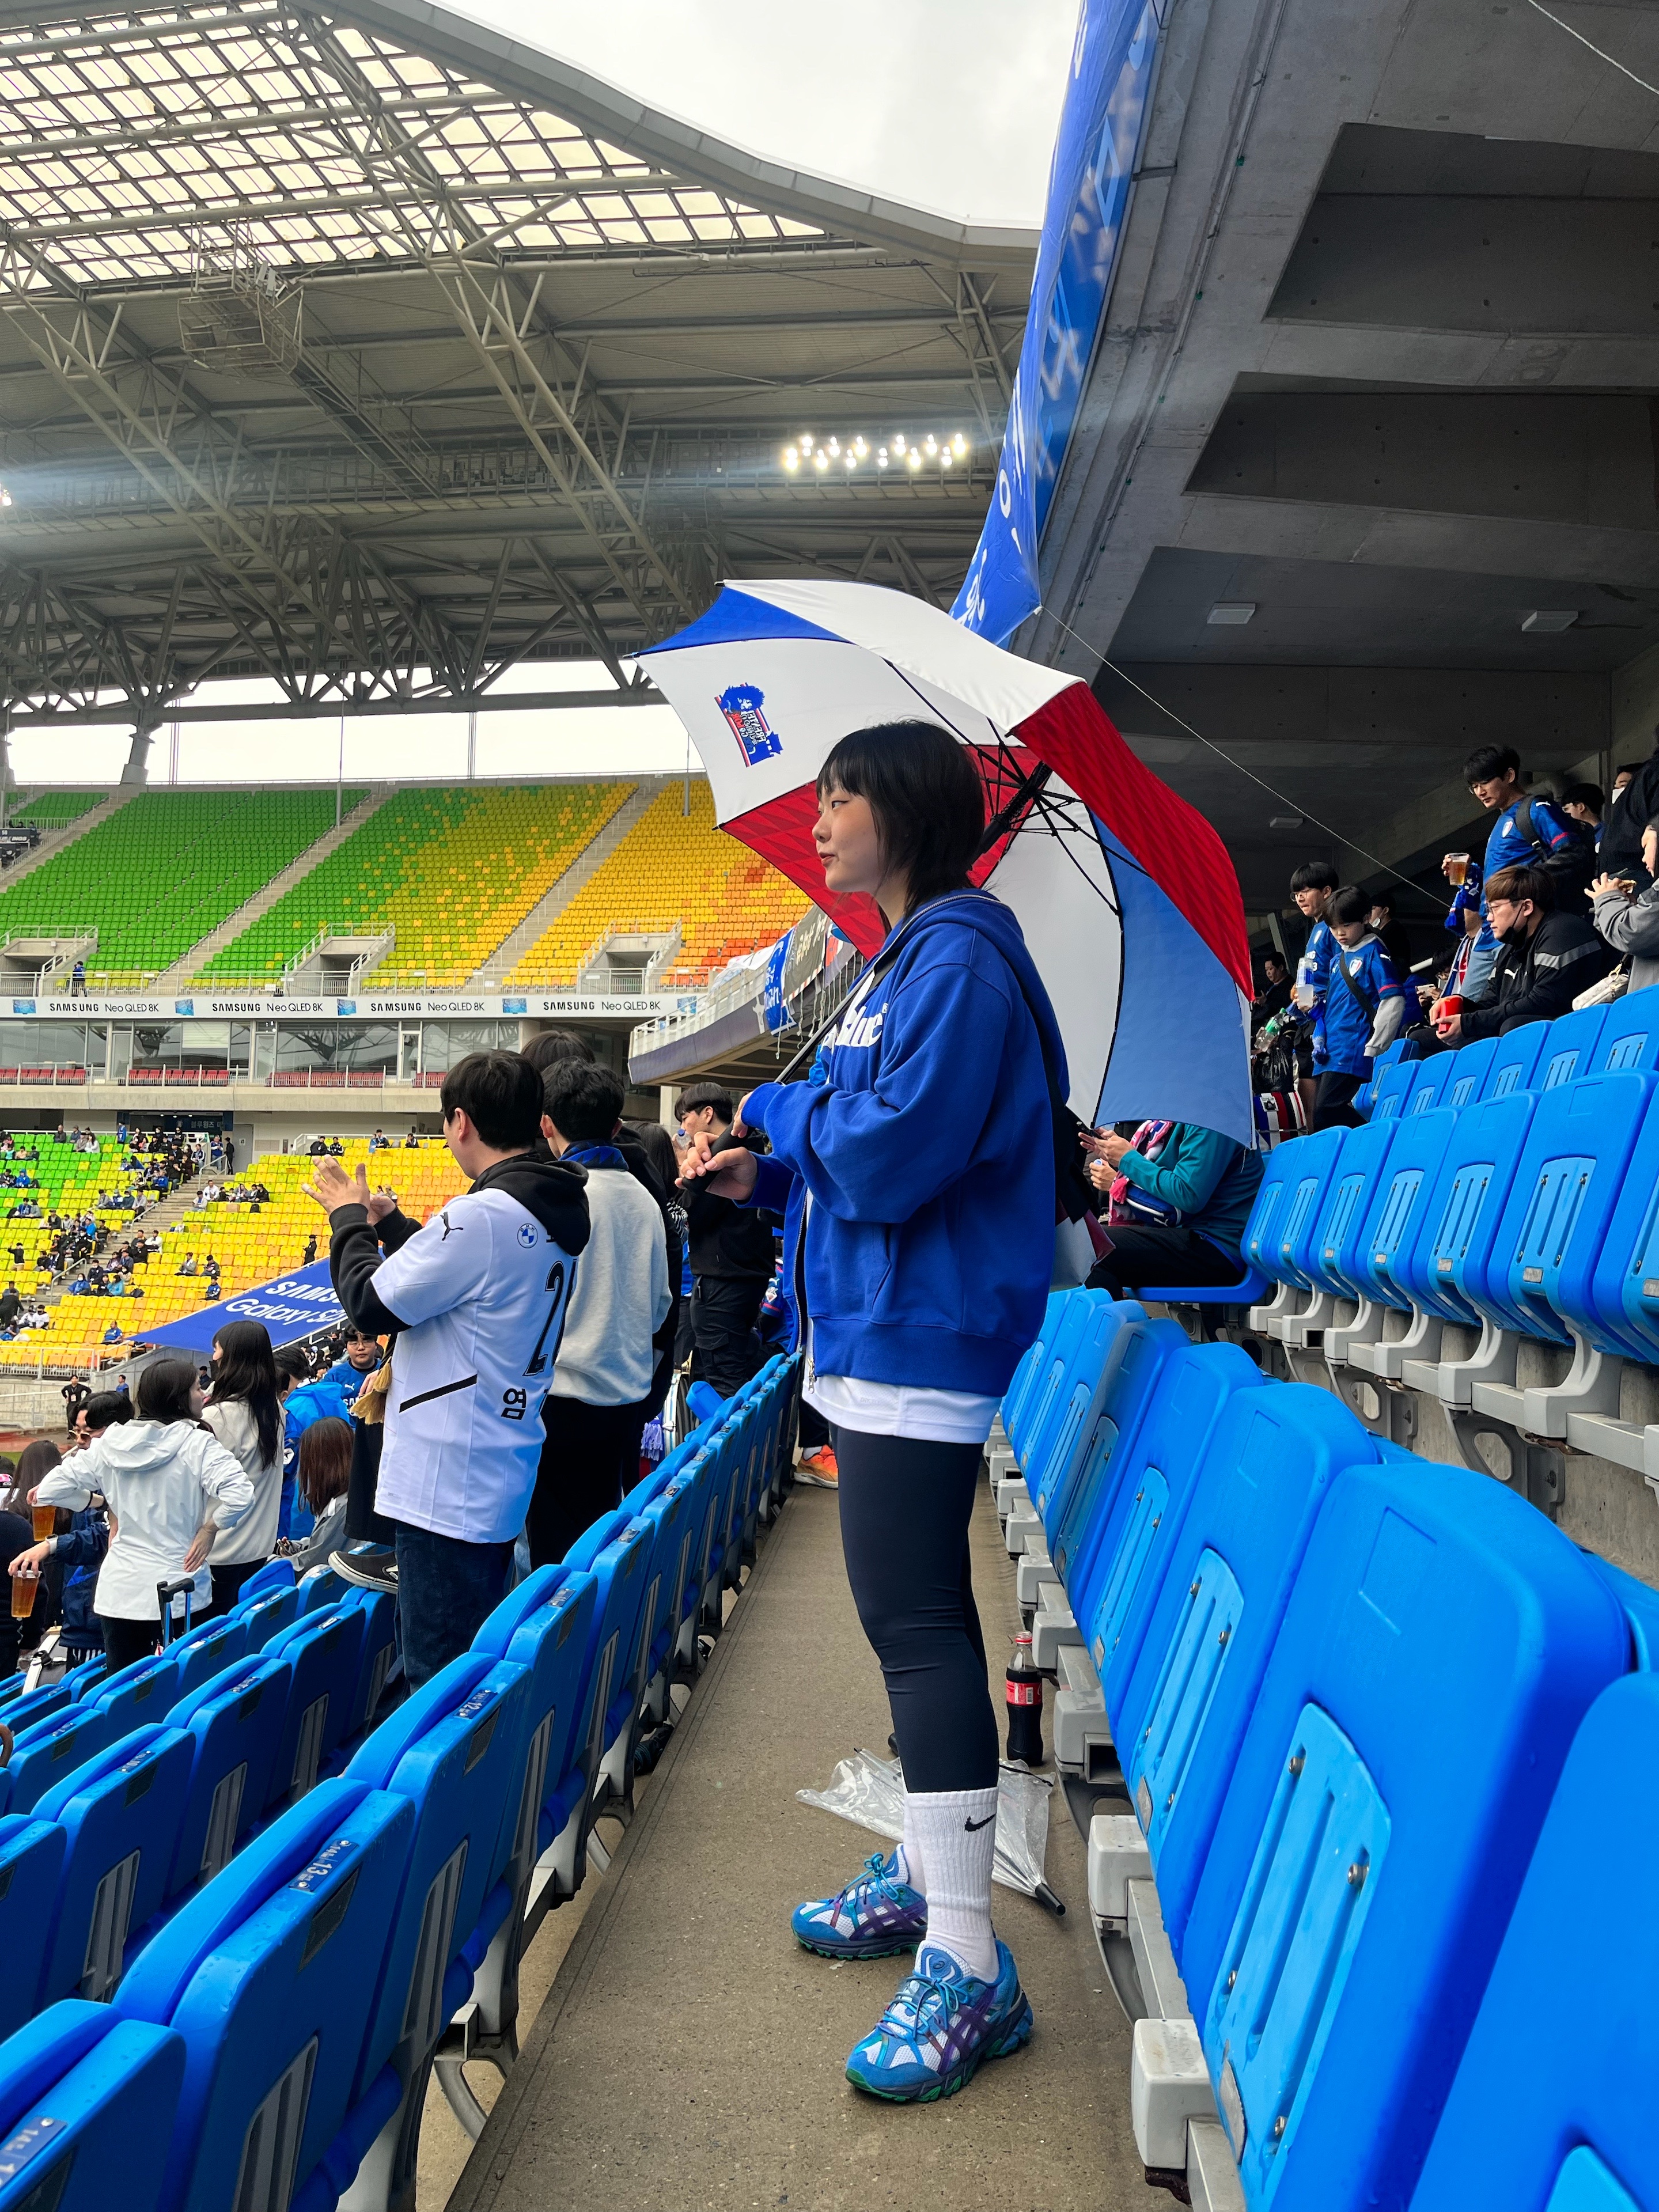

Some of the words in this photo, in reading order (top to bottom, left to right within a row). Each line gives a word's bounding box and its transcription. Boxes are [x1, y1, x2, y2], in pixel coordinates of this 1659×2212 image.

[50, 1003, 99, 1012] SAMSUNG
[105, 1003, 124, 1012] Neo
[124, 1003, 147, 1012] QLED
[149, 1003, 159, 1012] 8K
[212, 1003, 261, 1012] SAMSUNG
[267, 1003, 287, 1012] Neo
[288, 1003, 311, 1012] QLED
[313, 1003, 324, 1012] 8K
[370, 1002, 422, 1012] SAMSUNG
[428, 1002, 448, 1012] Neo
[449, 1002, 472, 1012] QLED
[474, 1002, 485, 1012] 8K
[543, 1001, 595, 1010] SAMSUNG
[601, 1001, 622, 1010] Neo
[623, 1001, 648, 1010] QLED
[649, 1001, 661, 1010] 8K
[225, 1298, 321, 1325] Galaxy
[463, 1702, 483, 1710] 12
[306, 1862, 332, 1876] 13
